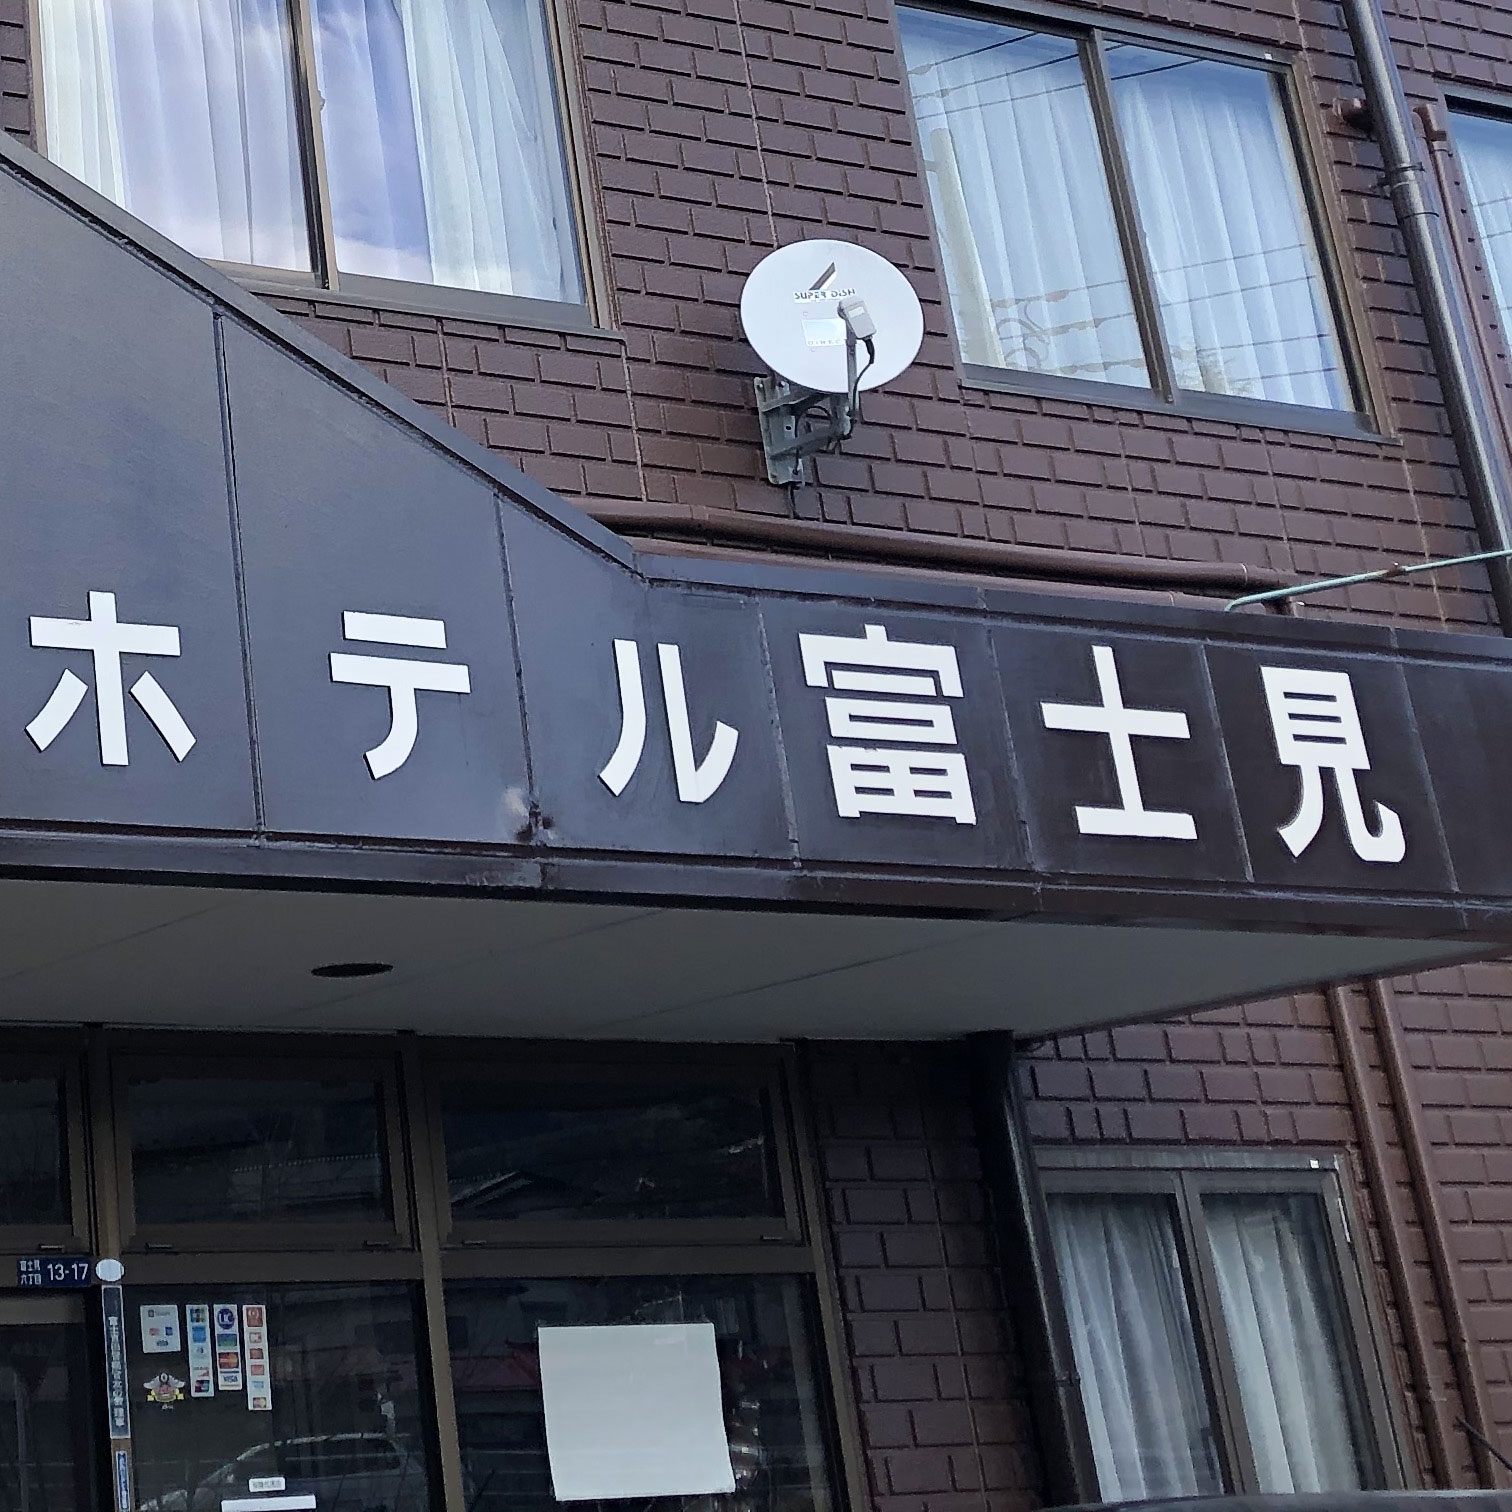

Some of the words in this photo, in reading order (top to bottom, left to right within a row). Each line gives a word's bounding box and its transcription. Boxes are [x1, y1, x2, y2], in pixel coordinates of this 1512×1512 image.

[794, 291, 827, 300] SUPER
[47, 1263, 89, 1281] 13-17
[20, 1273, 42, 1285] 六丁目
[224, 1375, 239, 1383] VISA
